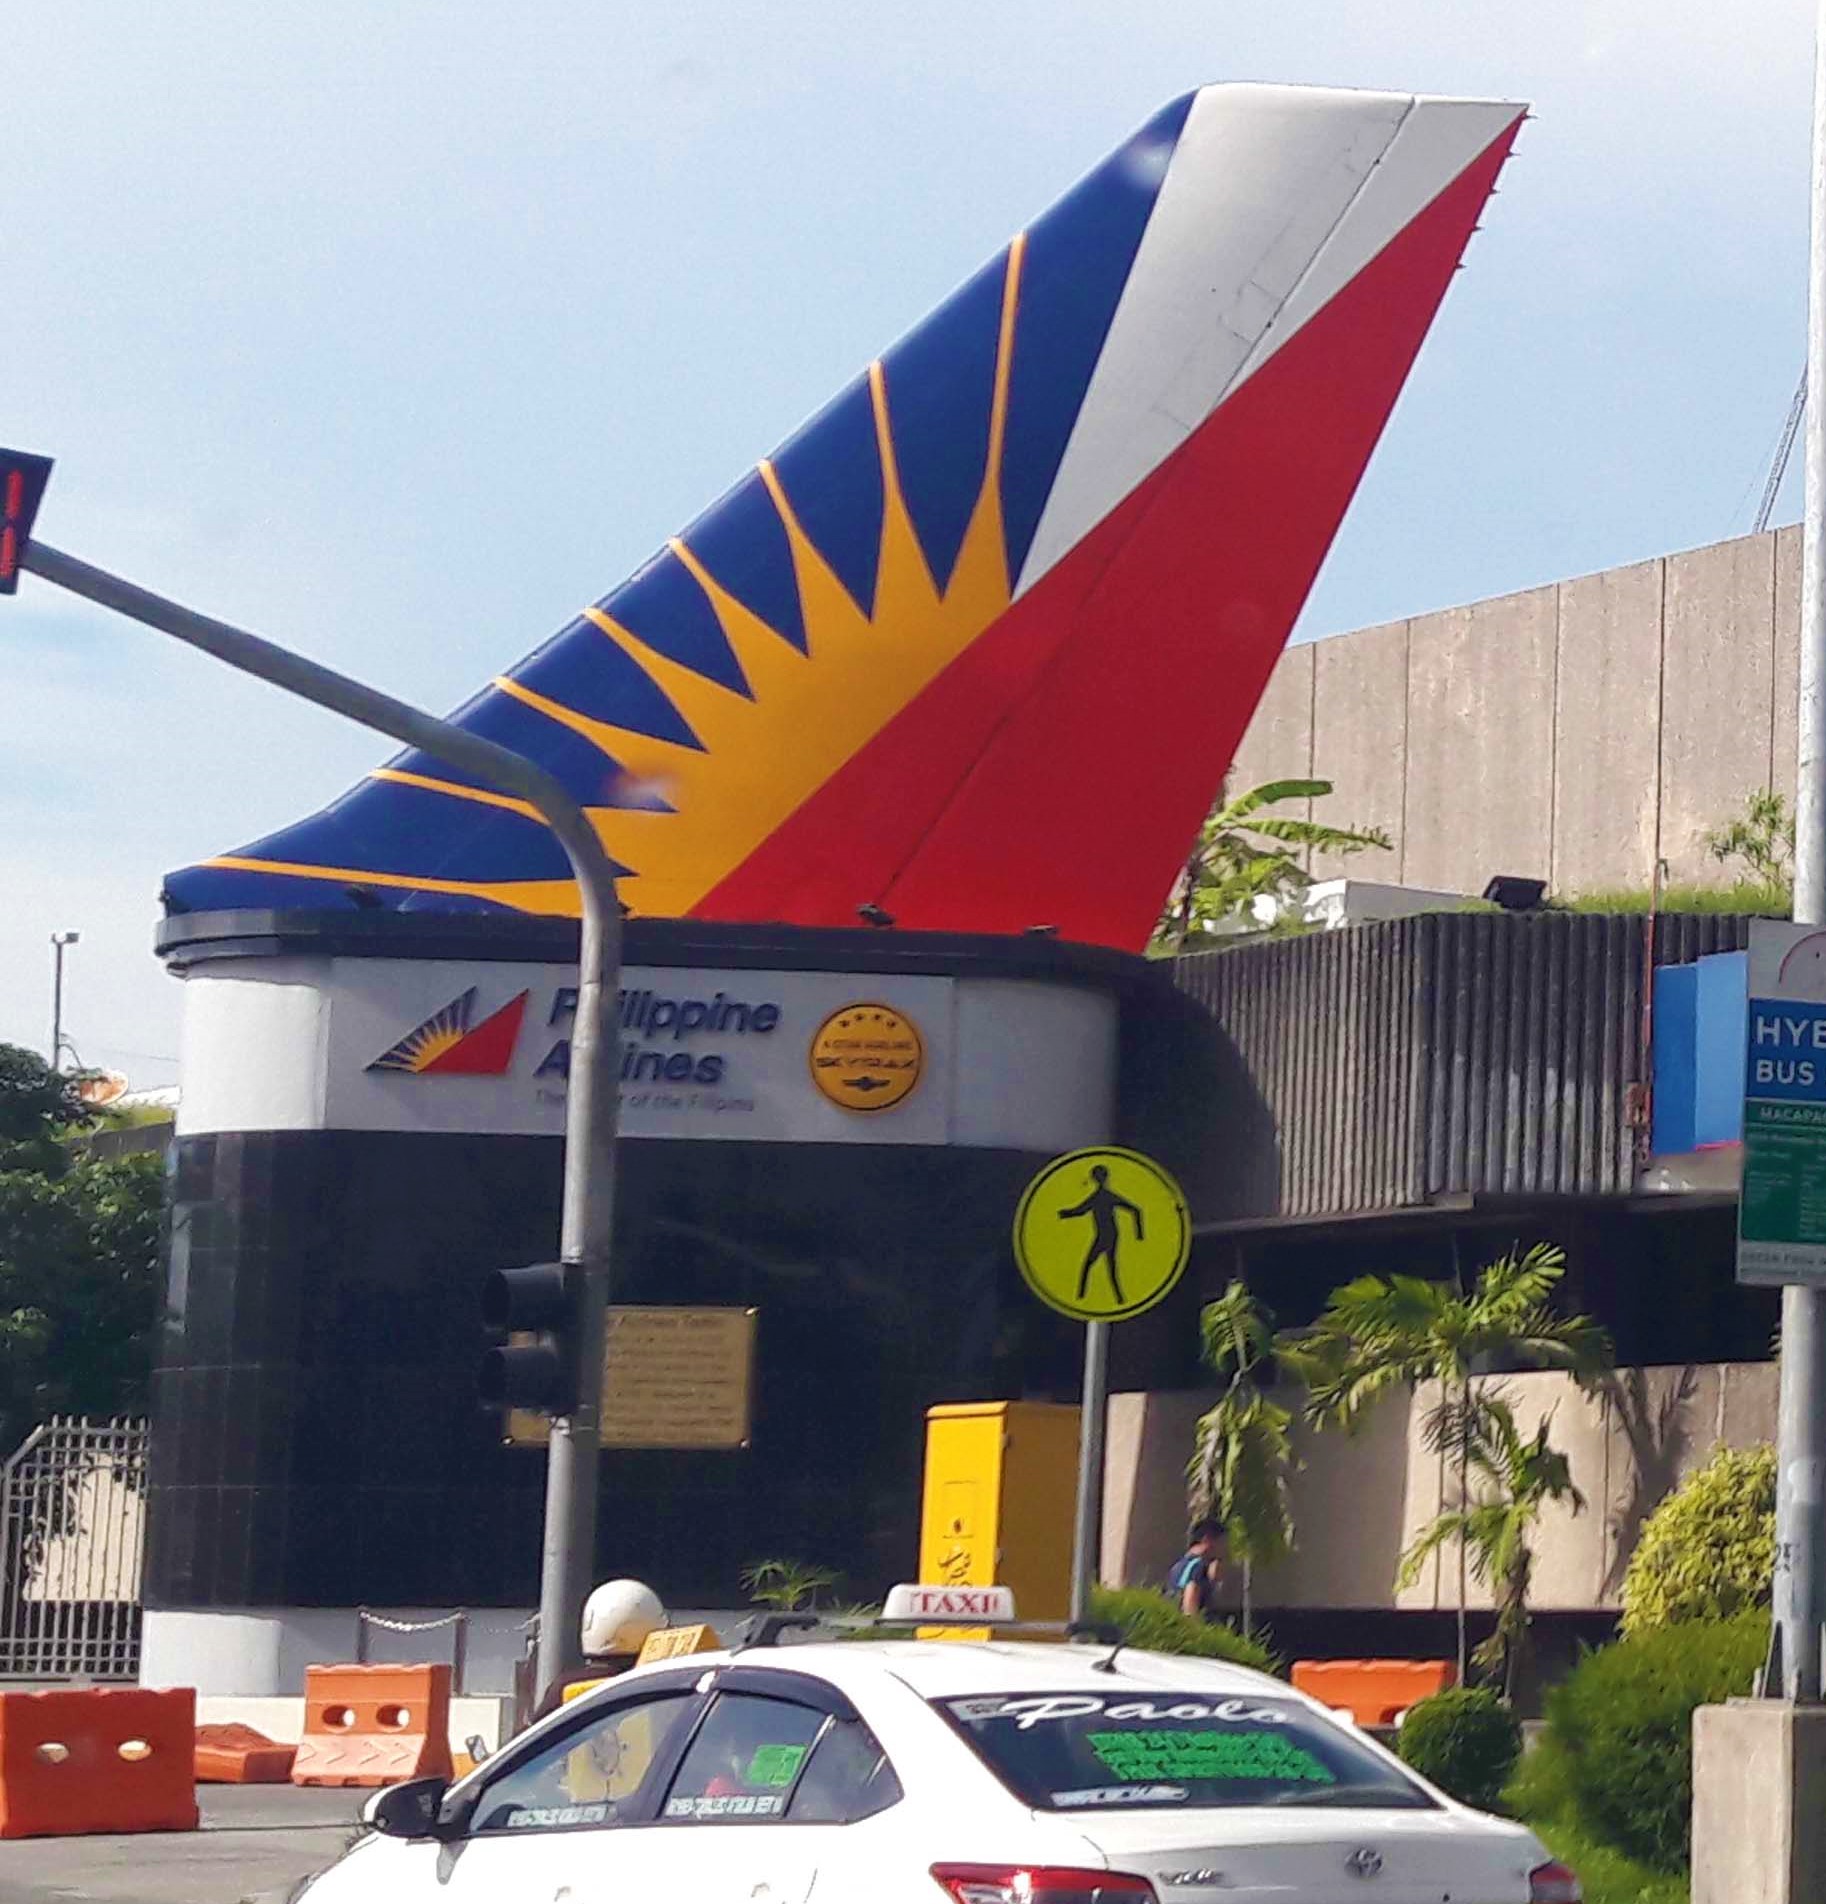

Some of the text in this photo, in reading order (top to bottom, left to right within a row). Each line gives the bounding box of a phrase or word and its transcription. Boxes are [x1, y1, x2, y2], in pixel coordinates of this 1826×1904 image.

[547, 987, 780, 1041] Pilippine
[533, 1039, 724, 1084] Aines
[1755, 1059, 1815, 1086] BUS
[915, 1592, 994, 1615] TAXI
[1000, 1696, 1293, 1730] Paolo
